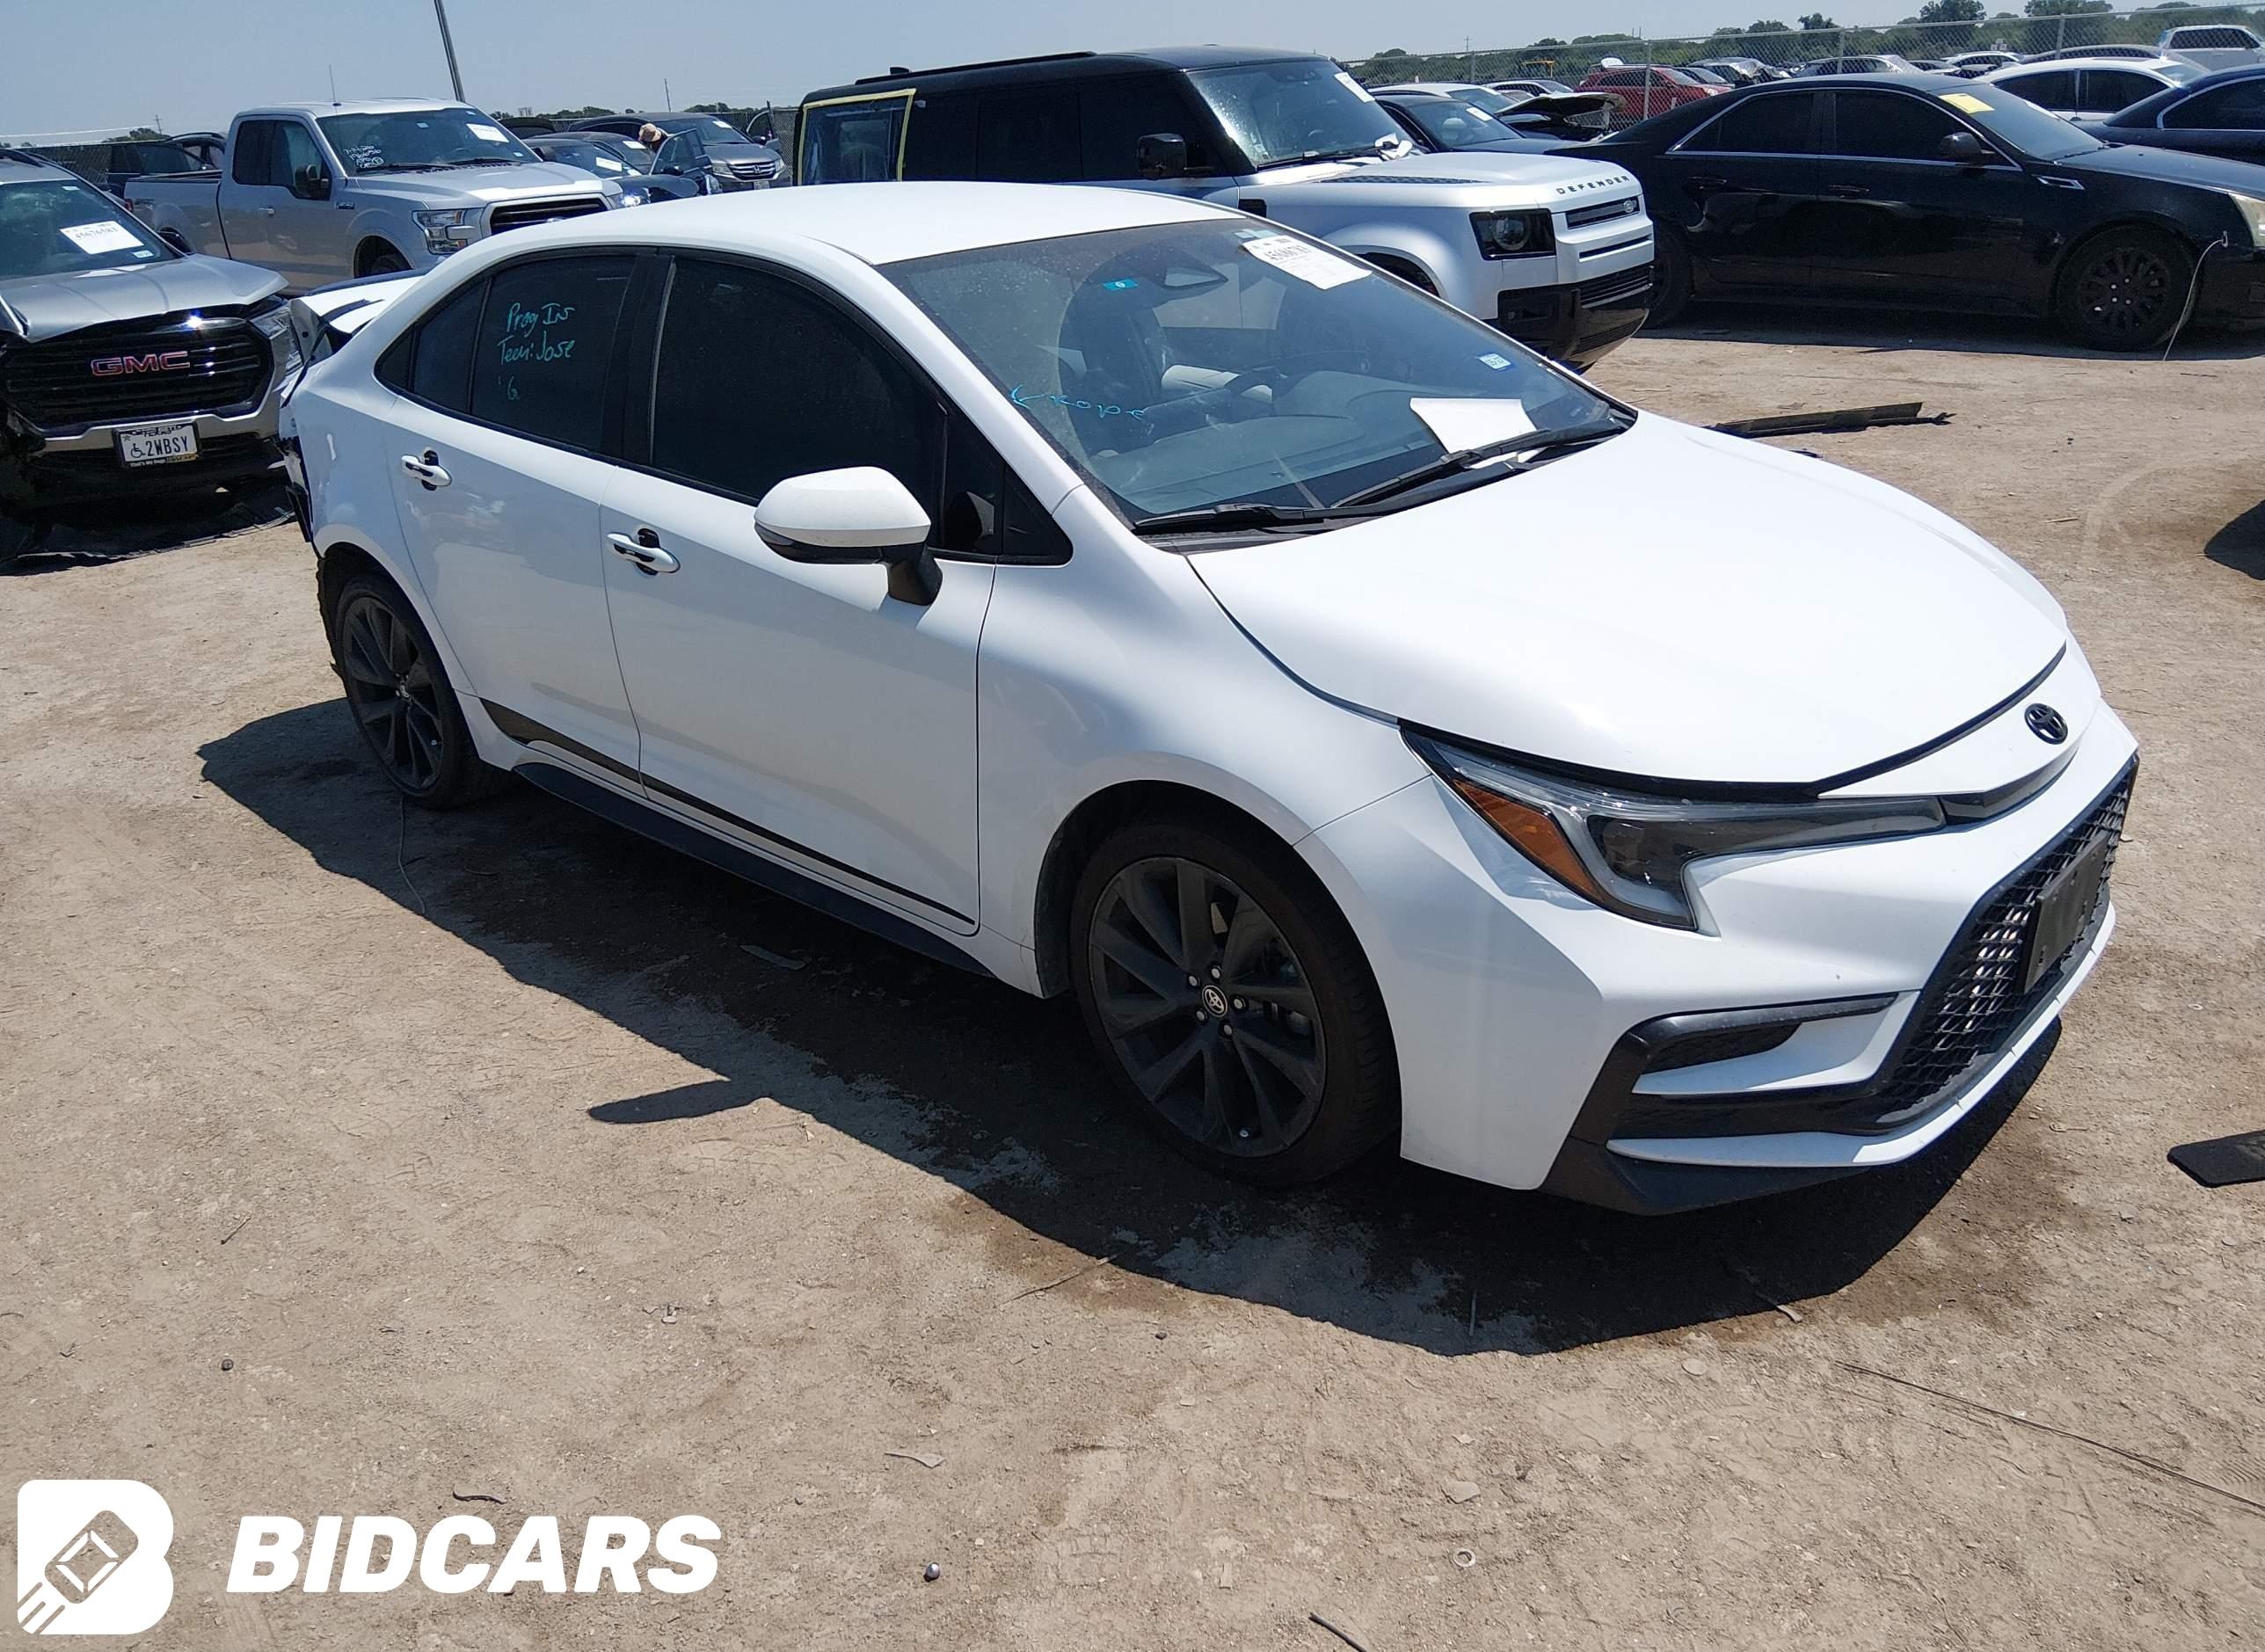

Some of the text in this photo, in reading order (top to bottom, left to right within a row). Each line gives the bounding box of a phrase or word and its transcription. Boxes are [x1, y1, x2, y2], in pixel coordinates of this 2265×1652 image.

[1555, 176, 1630, 194] DEFENDER
[91, 351, 190, 376] GMC
[145, 436, 188, 456] 2WBSY
